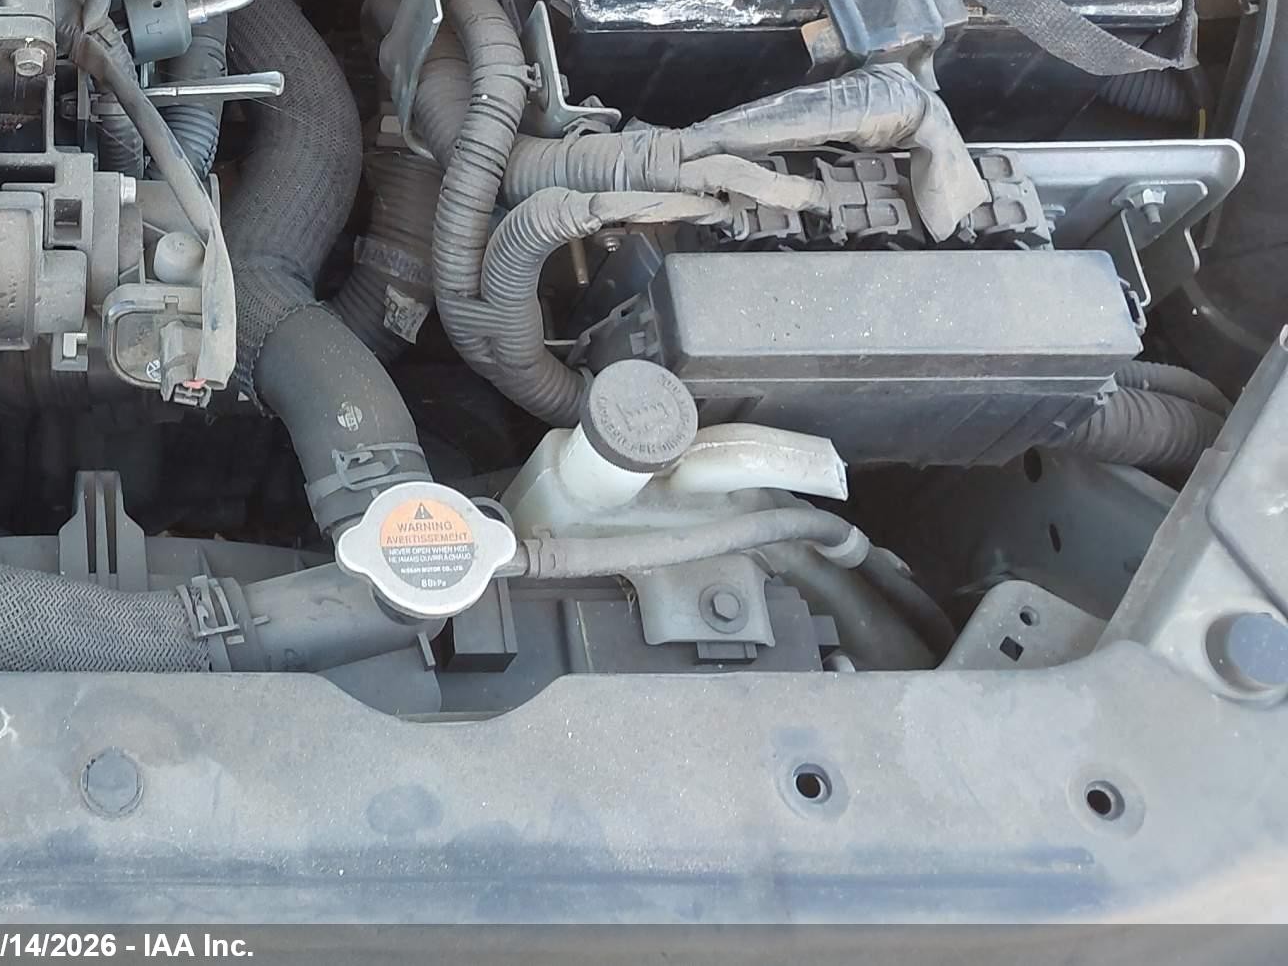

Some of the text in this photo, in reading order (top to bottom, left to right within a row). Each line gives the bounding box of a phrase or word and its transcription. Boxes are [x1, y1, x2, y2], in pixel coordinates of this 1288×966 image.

[397, 521, 452, 532] WARNING
[387, 532, 467, 544] AVERTISSEMENT
[432, 546, 454, 554] WHEN
